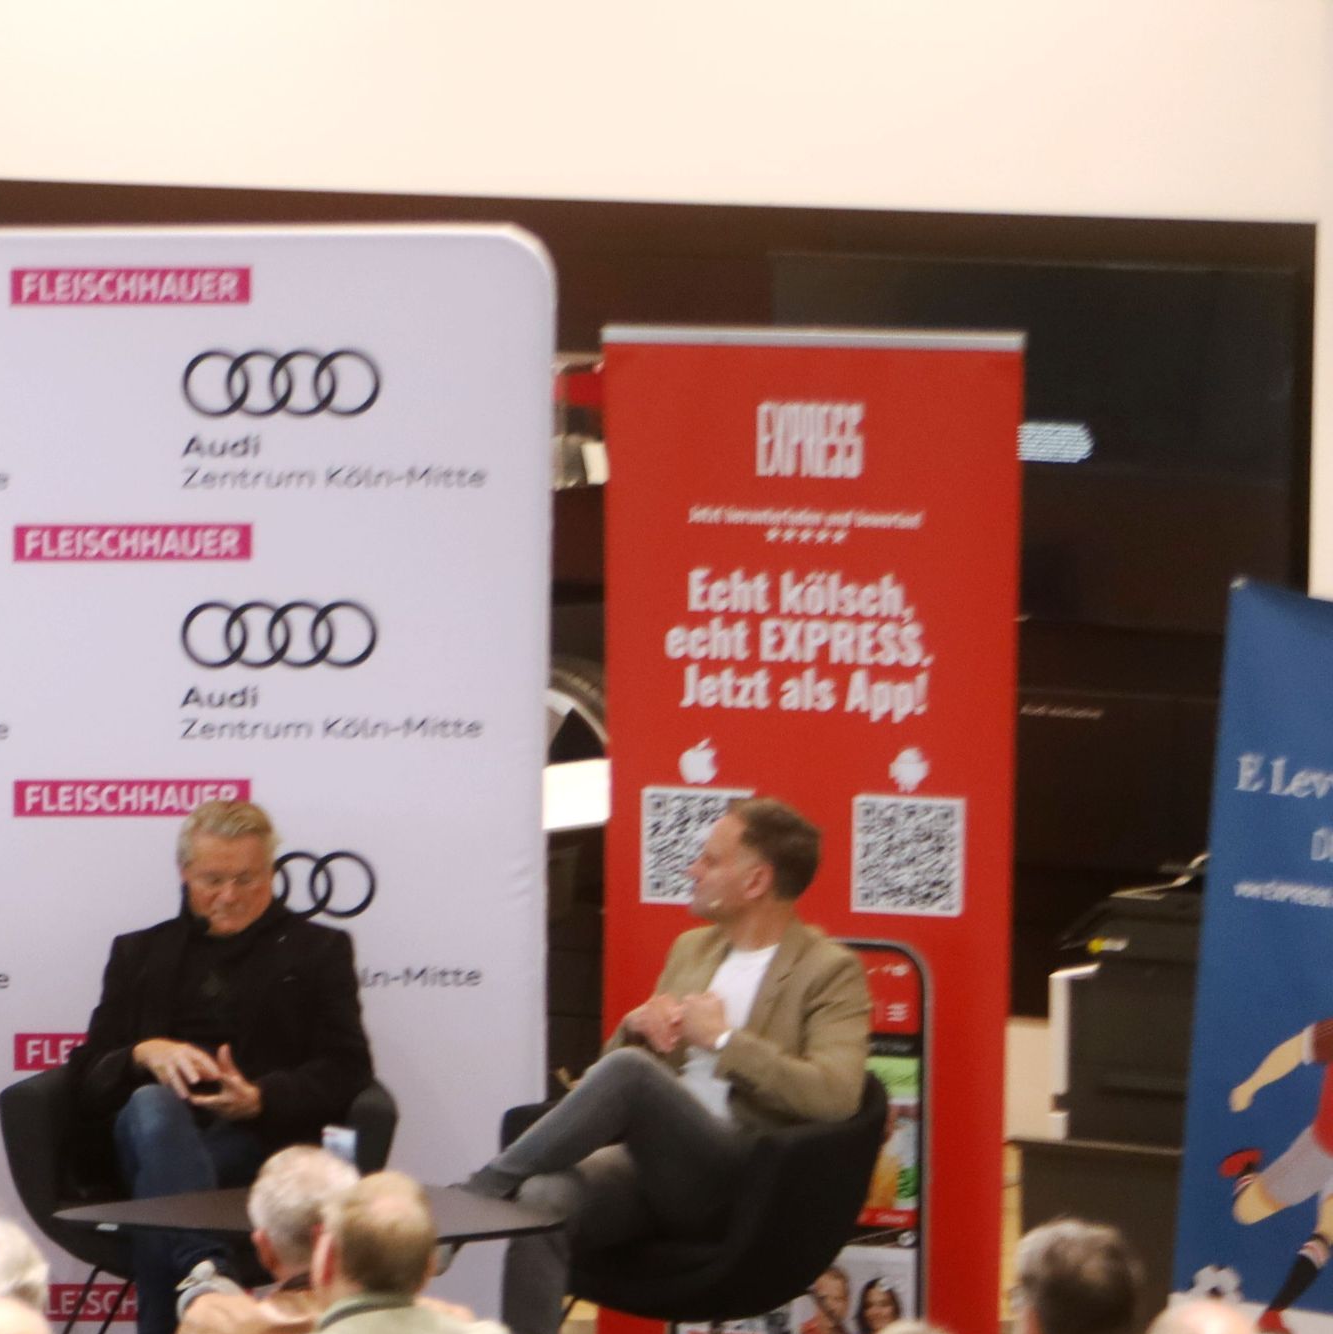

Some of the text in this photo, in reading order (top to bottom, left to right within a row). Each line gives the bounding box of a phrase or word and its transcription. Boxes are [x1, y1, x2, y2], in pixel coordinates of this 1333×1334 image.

[22, 274, 238, 300] FLEISCHHAUER
[182, 435, 259, 456] Audi
[756, 401, 864, 478] EXPRESS
[182, 466, 487, 488] Zentrum Köln-Mitte
[25, 530, 239, 557] FLEISCHHAUER
[687, 567, 915, 624] Echt kölsch,
[664, 616, 934, 667] echt EXPRESS.
[180, 687, 258, 707] Audi
[680, 664, 929, 723] Jetzt als App!
[181, 717, 483, 738] Zentrum Köln-Mitte
[1235, 753, 1333, 798] E Lev
